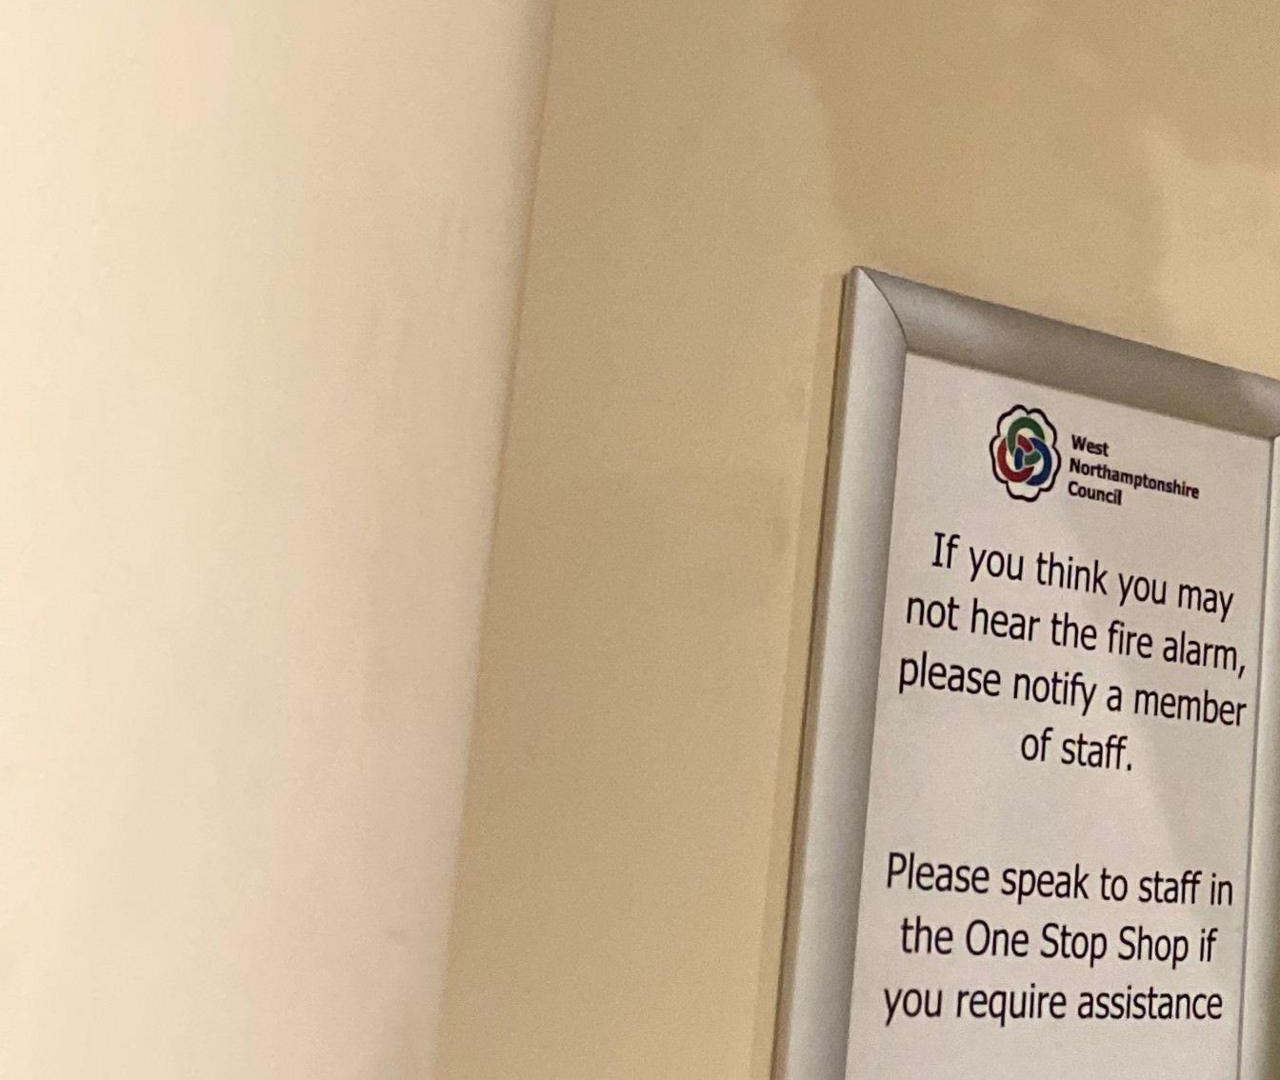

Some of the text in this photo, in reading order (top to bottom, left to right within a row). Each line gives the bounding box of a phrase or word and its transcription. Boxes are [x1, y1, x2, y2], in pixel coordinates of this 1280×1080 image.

[1071, 433, 1110, 458] West
[1067, 480, 1123, 506] Council
[1068, 457, 1200, 500] Northamptonshire
[931, 531, 1235, 624] If you think you may
[906, 596, 1246, 680] not hear the fire alarm,
[898, 650, 1248, 727] please notify a member
[1020, 726, 1132, 772] of staff.
[886, 851, 1233, 906] Please speak to staff in
[900, 915, 1219, 971] the One Stop Shop if
[883, 982, 1223, 1028] you require assistance
